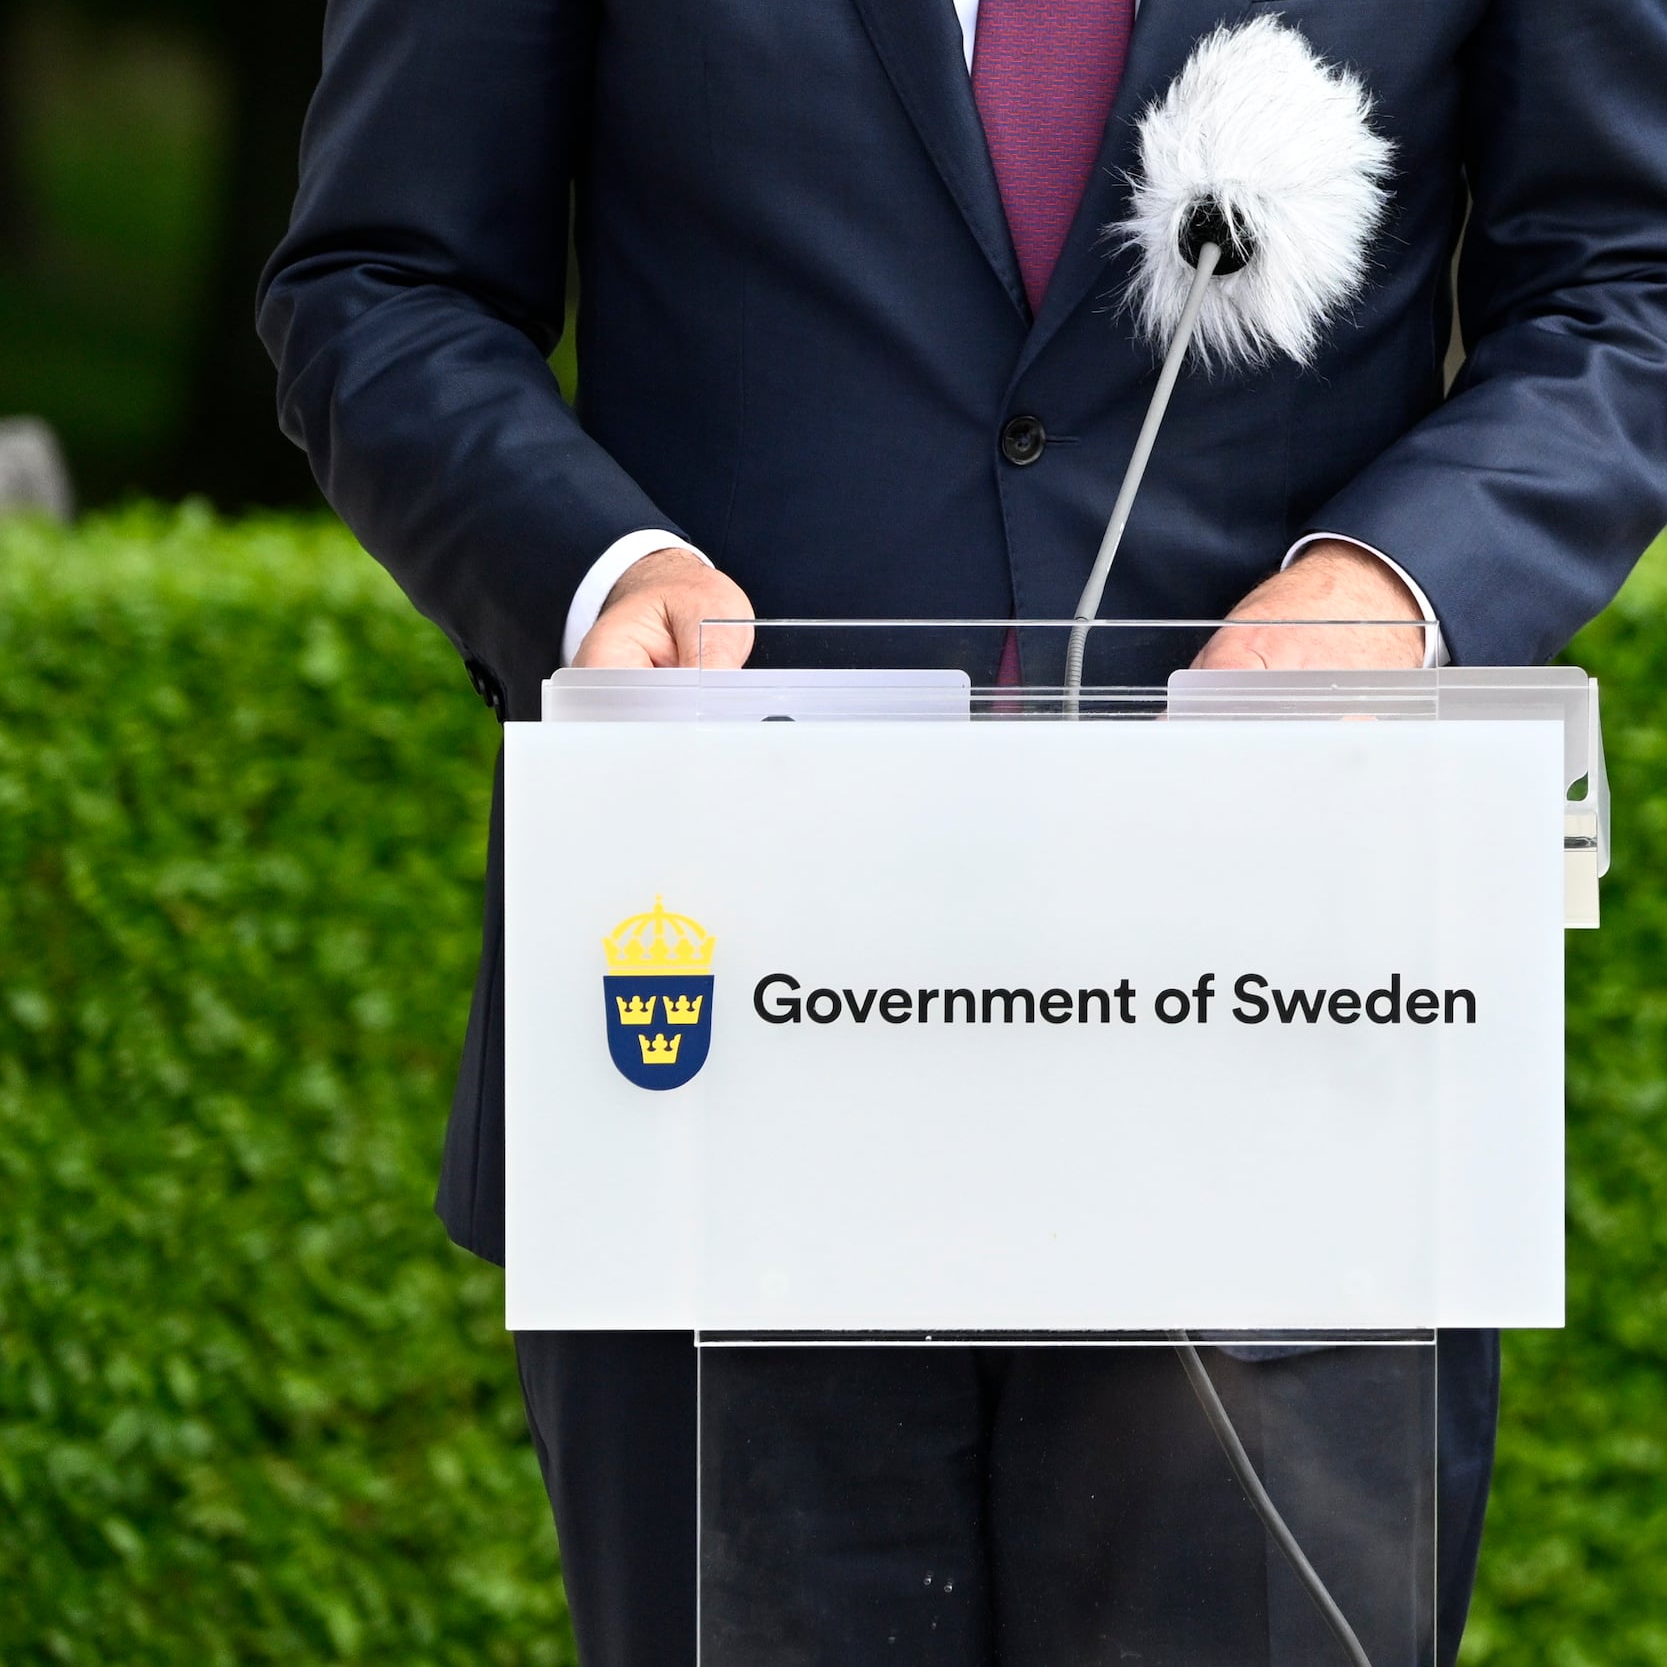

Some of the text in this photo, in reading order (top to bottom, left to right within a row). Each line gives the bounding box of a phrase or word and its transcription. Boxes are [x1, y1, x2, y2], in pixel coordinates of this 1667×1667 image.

[753, 972, 1477, 1025] Government of Sweden
